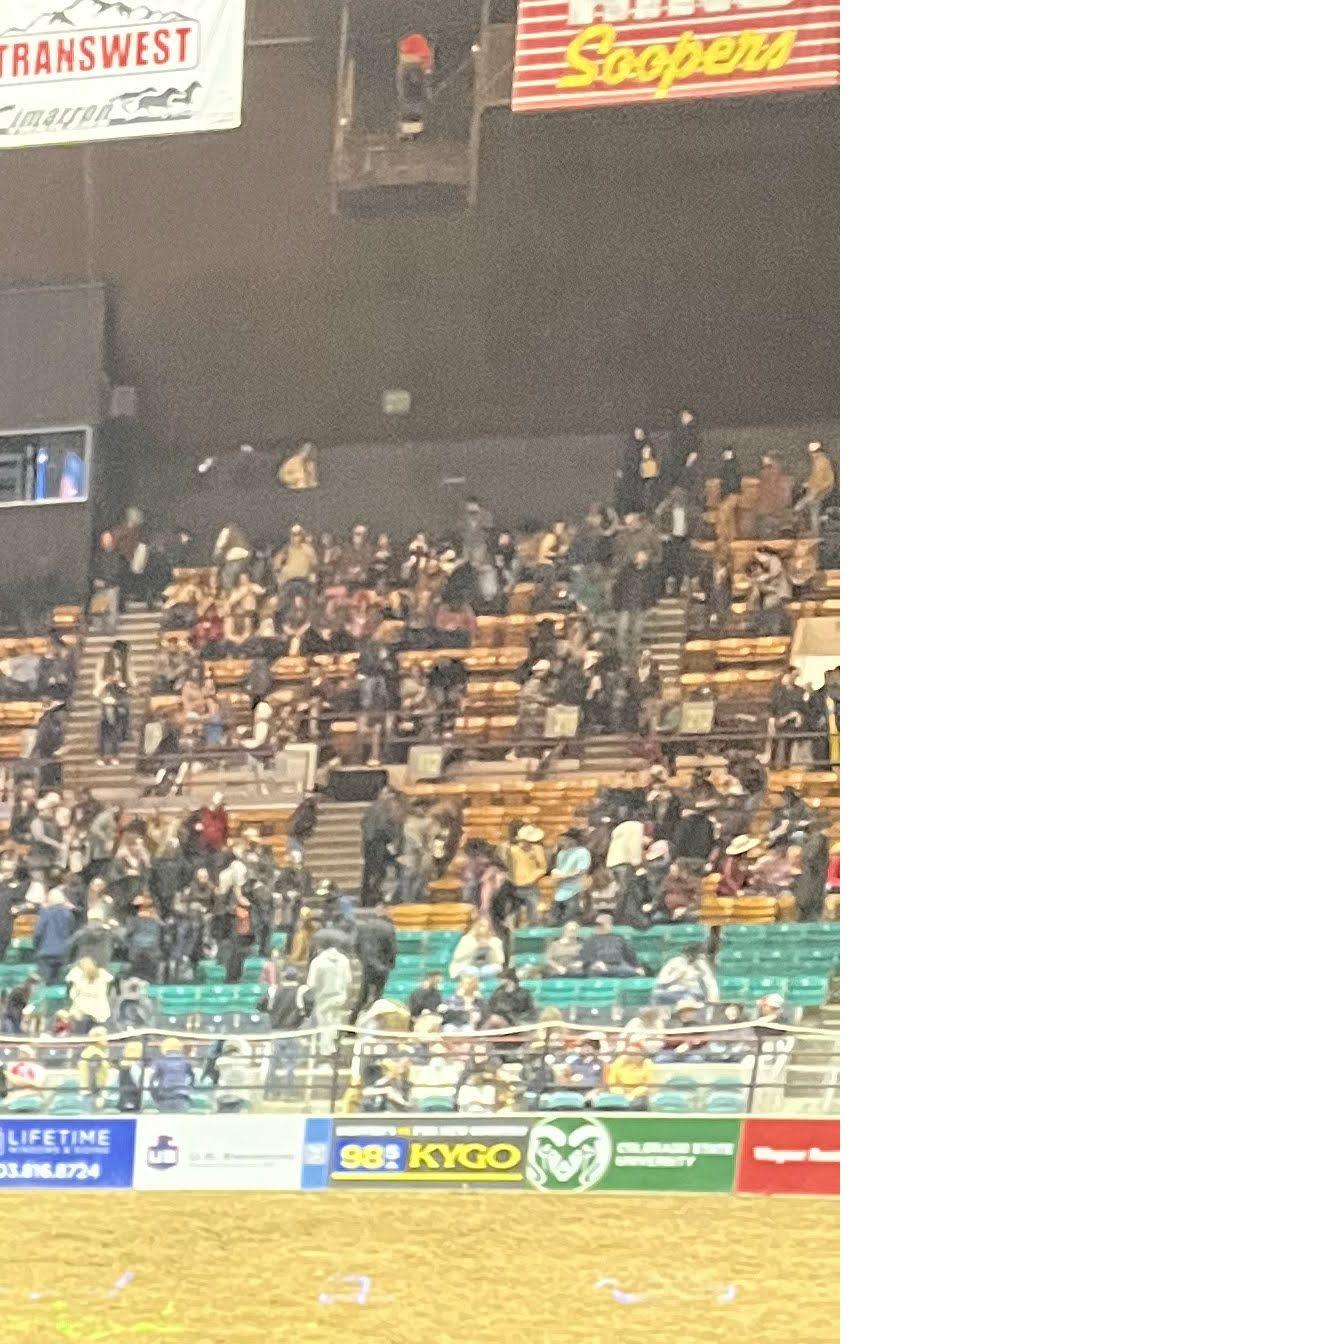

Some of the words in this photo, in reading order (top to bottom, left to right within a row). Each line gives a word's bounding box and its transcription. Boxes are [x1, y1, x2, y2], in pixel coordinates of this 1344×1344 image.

[555, 23, 799, 99] Soopers
[7, 1129, 111, 1147] LIFETIME
[409, 1142, 522, 1170] KYGO
